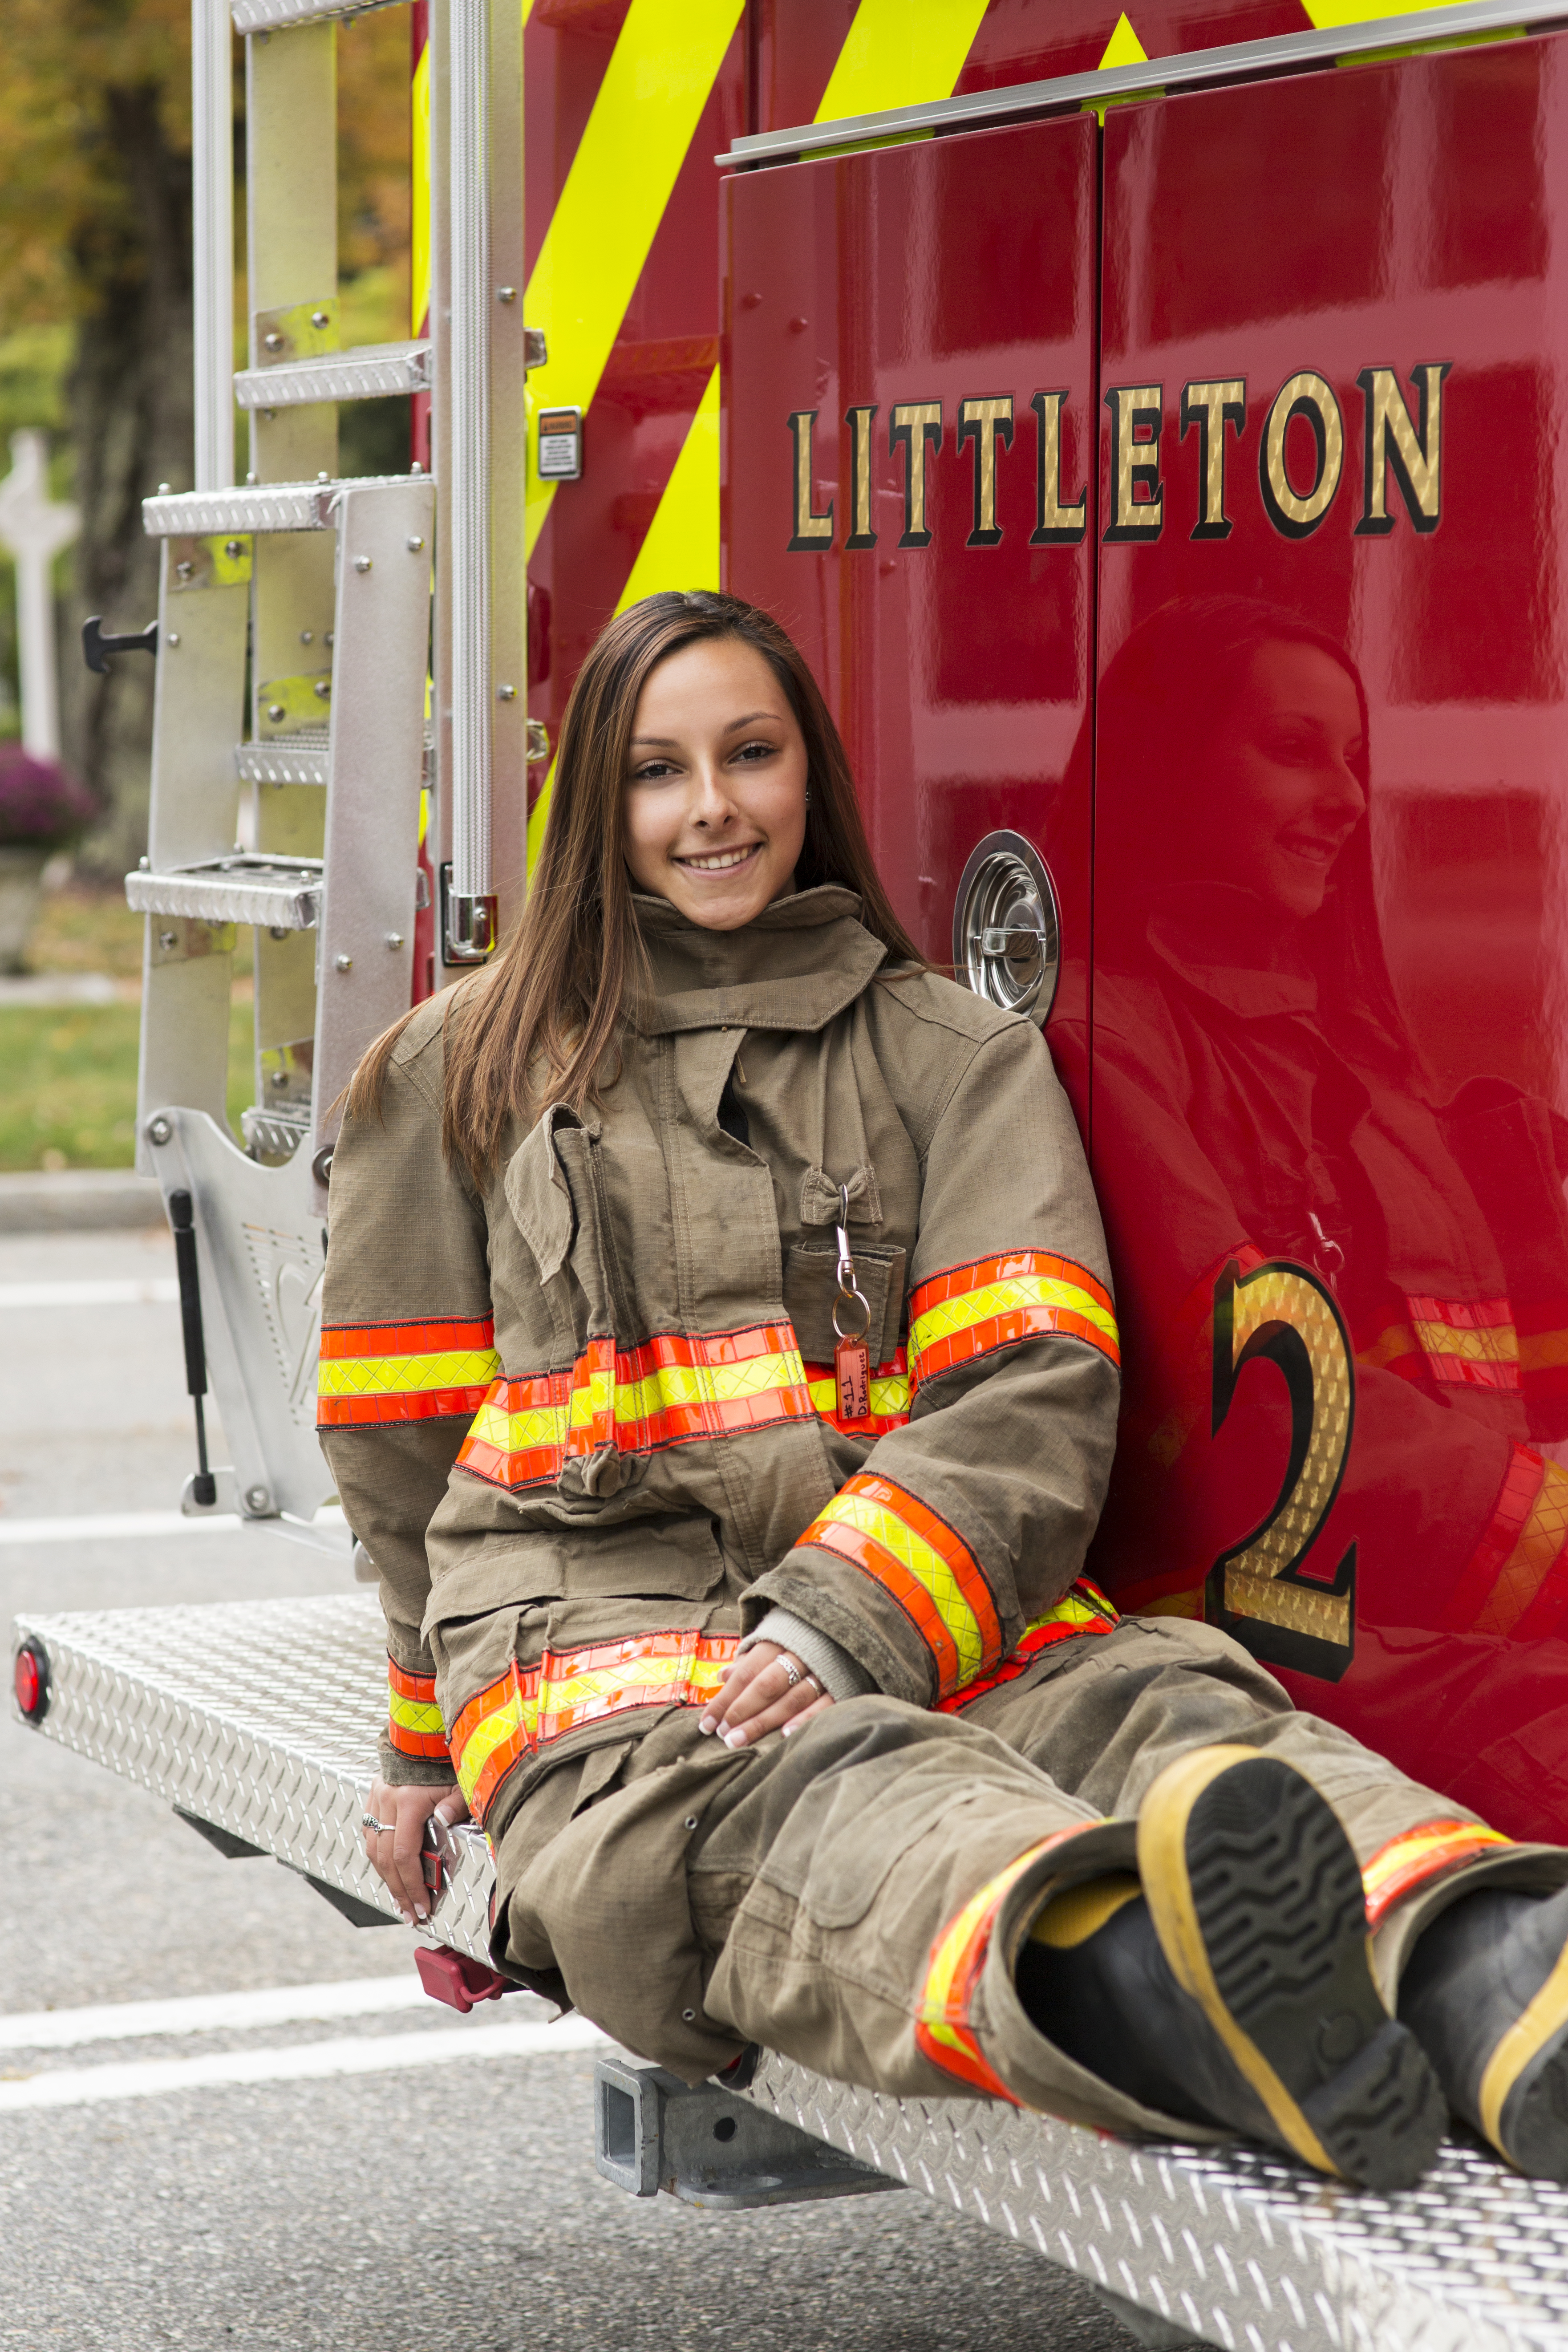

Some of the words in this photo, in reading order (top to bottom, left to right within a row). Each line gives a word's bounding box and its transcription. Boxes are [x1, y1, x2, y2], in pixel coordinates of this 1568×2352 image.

[786, 361, 1453, 551] LITTLETON
[841, 1375, 855, 1419] #11
[1204, 1258, 1356, 1684] 2
